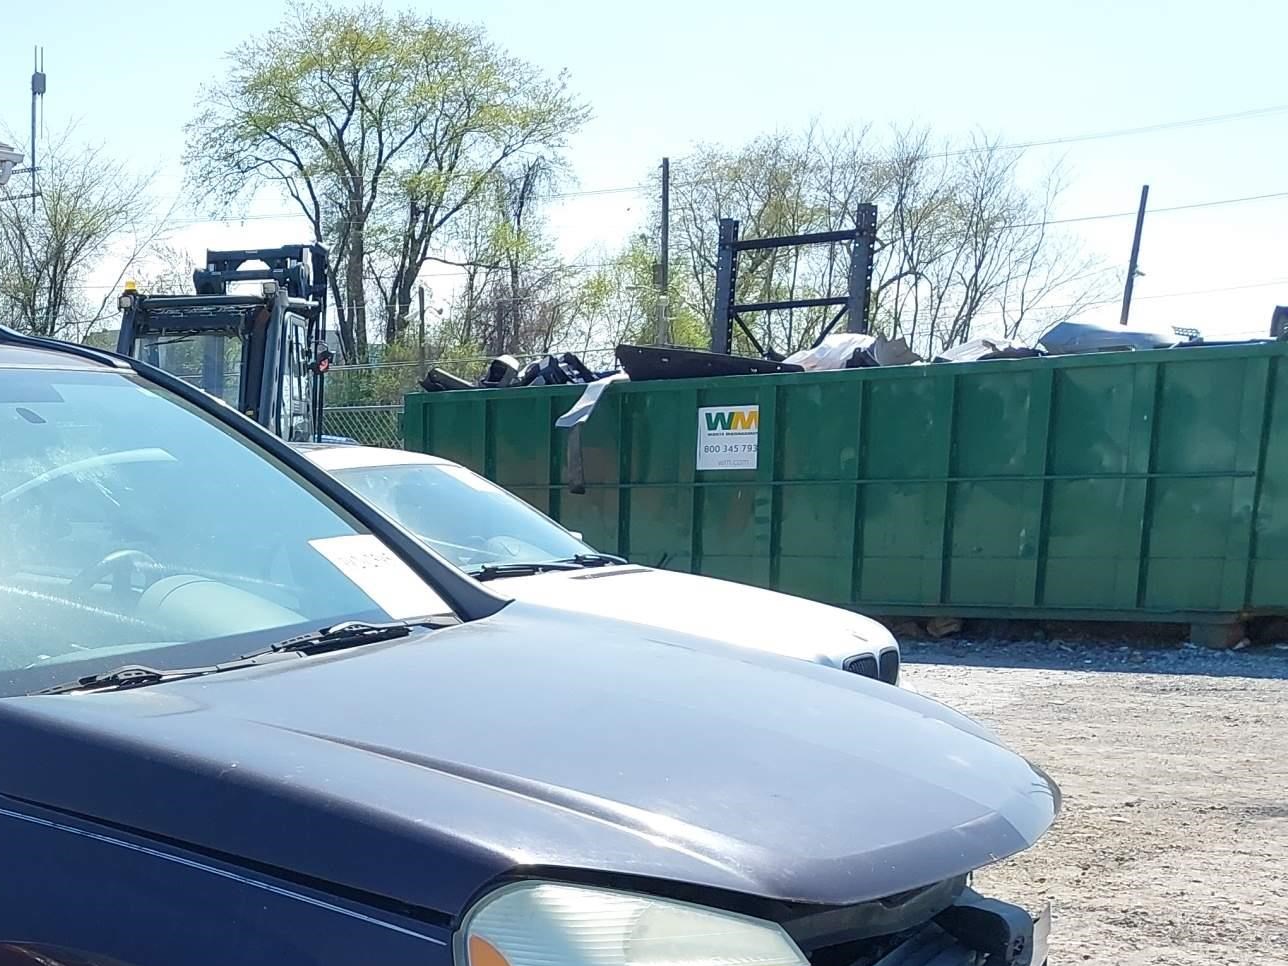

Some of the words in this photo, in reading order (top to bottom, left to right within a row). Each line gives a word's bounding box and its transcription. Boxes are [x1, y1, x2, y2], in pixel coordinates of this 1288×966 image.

[705, 410, 759, 431] WM
[704, 444, 721, 453] 800
[722, 443, 739, 453] 345
